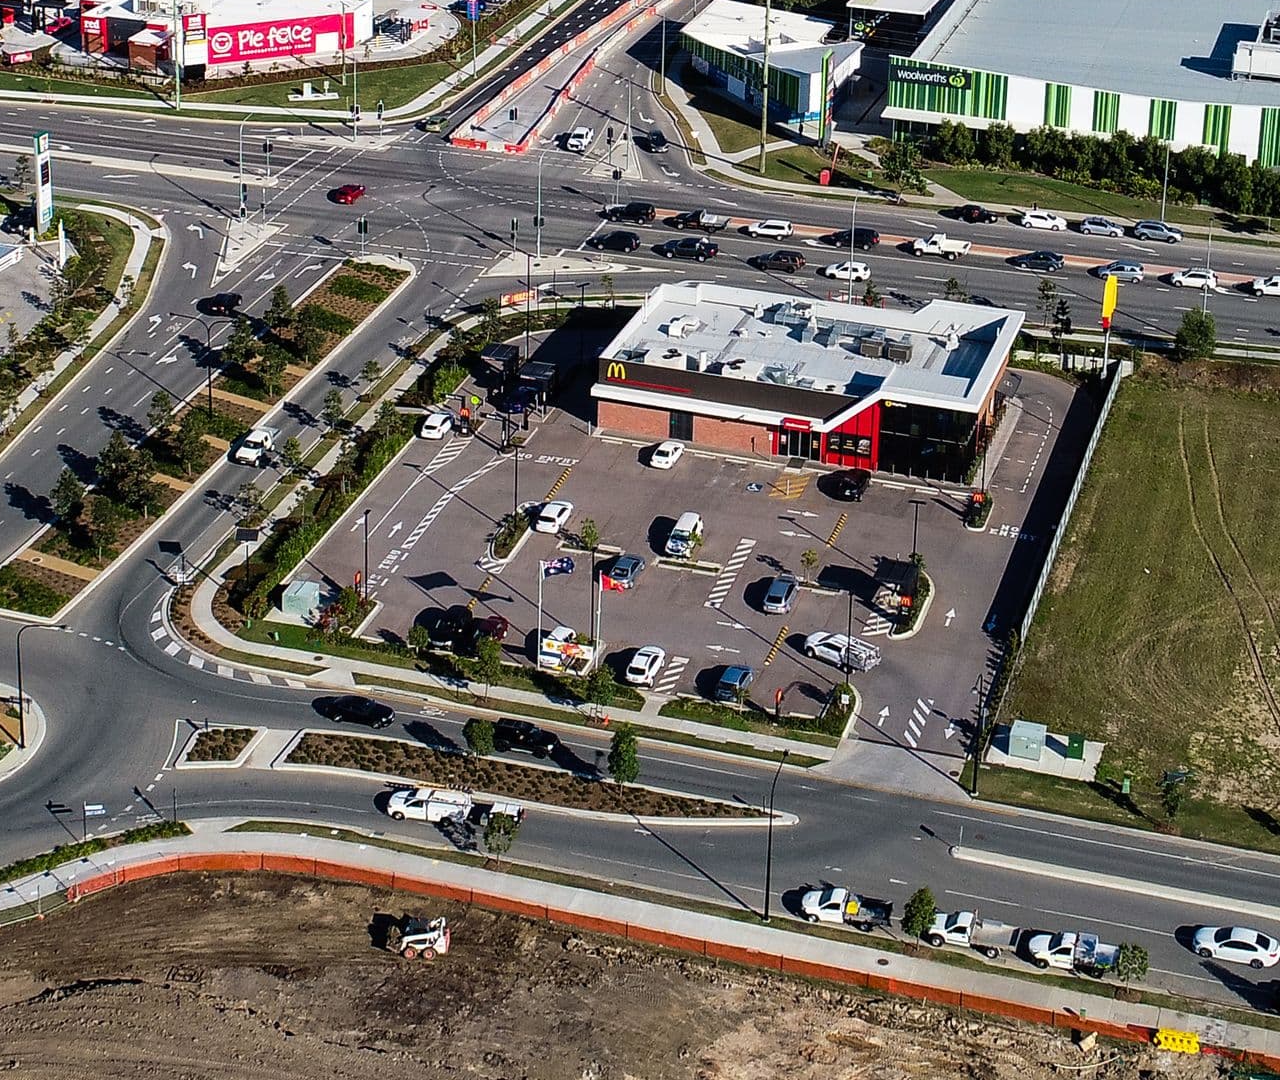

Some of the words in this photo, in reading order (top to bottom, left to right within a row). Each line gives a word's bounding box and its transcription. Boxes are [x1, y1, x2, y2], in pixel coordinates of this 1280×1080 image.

[84, 20, 100, 29] red
[238, 29, 265, 50] Pie
[266, 25, 313, 45] face
[897, 69, 947, 84] Woolworths
[535, 455, 580, 467] ENTRY
[1000, 524, 1020, 532] NO
